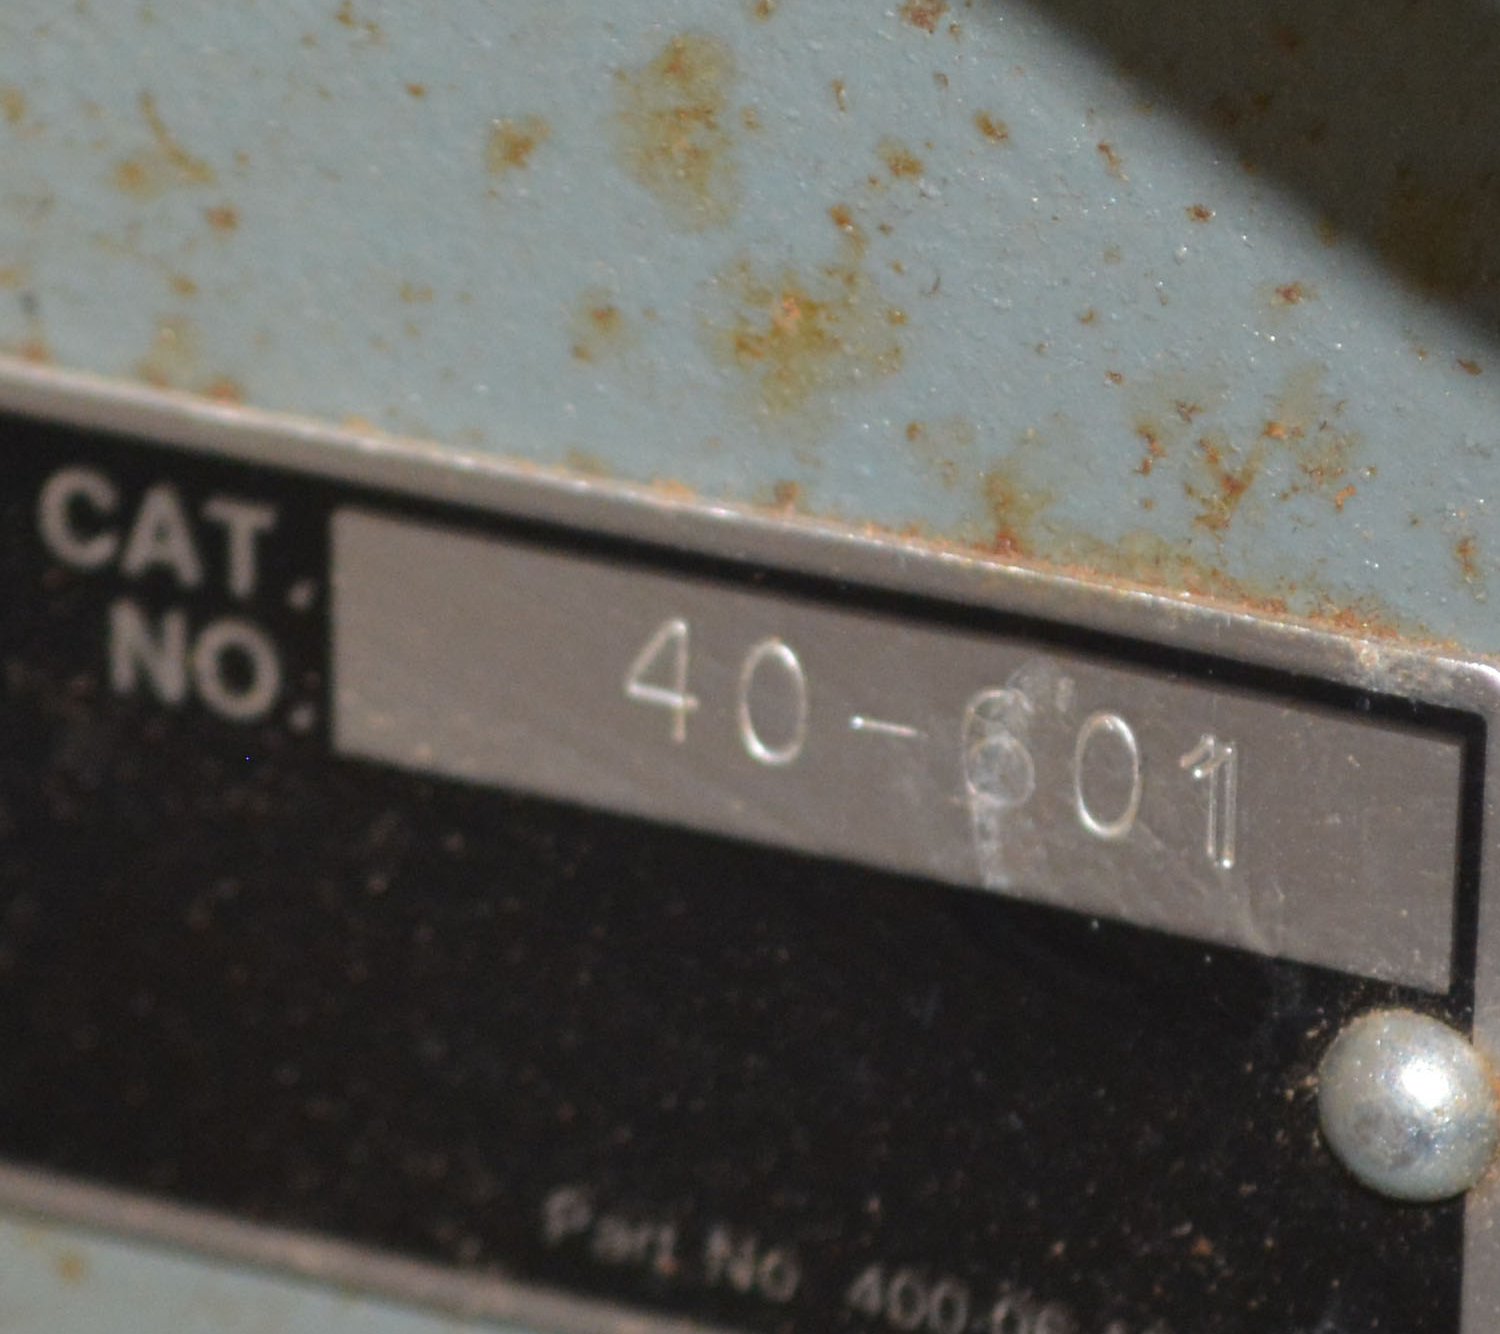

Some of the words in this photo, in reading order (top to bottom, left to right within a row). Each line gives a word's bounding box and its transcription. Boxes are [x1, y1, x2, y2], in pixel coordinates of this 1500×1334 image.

[37, 466, 316, 610] CAT.
[107, 597, 316, 735] NO.
[543, 1183, 680, 1269] Part
